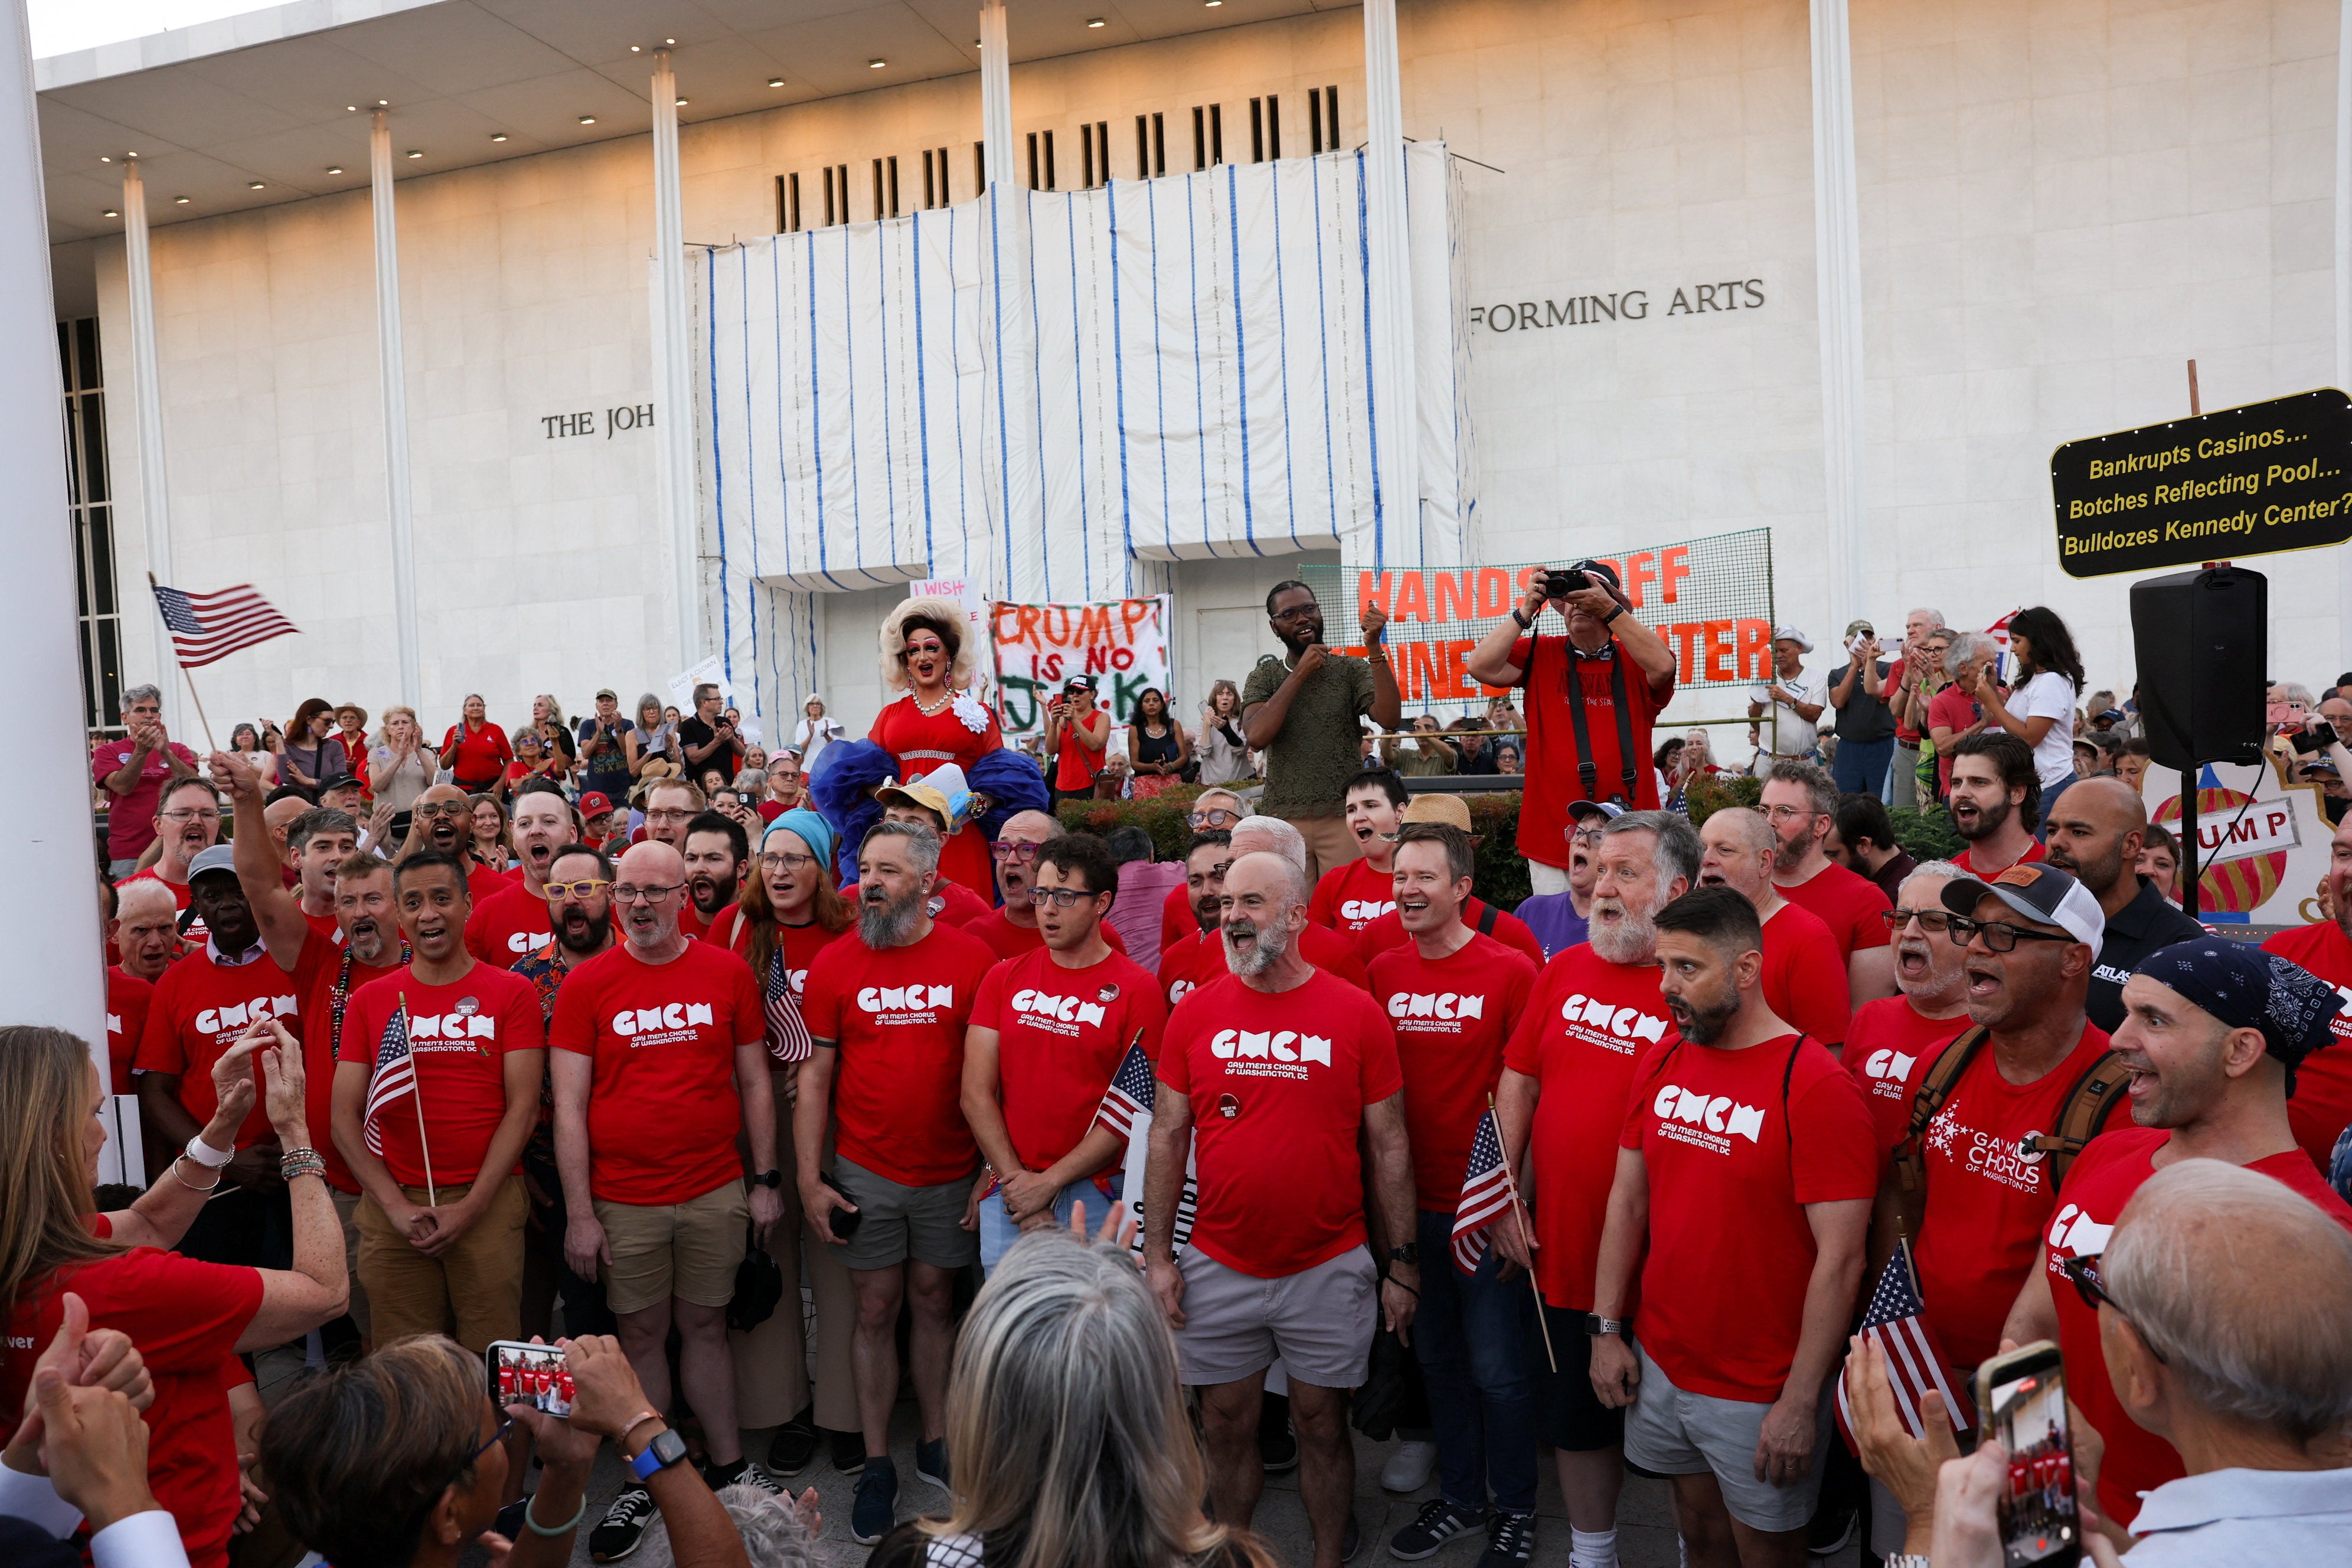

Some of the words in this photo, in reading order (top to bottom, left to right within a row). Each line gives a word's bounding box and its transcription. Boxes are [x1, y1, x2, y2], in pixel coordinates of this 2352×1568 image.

[1667, 278, 1765, 316] ARTS
[541, 411, 594, 440] THE
[606, 403, 654, 440] JOH
[2089, 443, 2190, 479] Bankrupts
[2069, 488, 2148, 519] Botches
[2155, 472, 2259, 505] Reflecting
[2064, 527, 2158, 556] Bulldozes
[2165, 510, 2258, 541] Kennedy
[2264, 492, 2352, 527] Center?
[914, 584, 919, 596] I
[925, 580, 965, 596] WISH
[671, 675, 688, 689] ELECT
[694, 659, 717, 675] CLOWN
[1031, 653, 1064, 681] IS
[1084, 645, 1135, 675] NO
[1056, 1023, 1080, 1031] CHORUS
[1569, 1024, 1585, 1033] GAY
[1609, 1037, 1636, 1048] CHORUS
[1624, 1047, 1635, 1056] DC
[1227, 1061, 1244, 1069] GAY
[1273, 1064, 1308, 1073] CHORUS
[1297, 1072, 1309, 1080] DC
[1876, 1081, 1893, 1090] GAY
[1661, 1122, 1678, 1132] GAY
[1703, 1133, 1731, 1147] CHORUS
[1974, 1132, 2005, 1152] GAY
[1719, 1146, 1730, 1156] DC
[1965, 1163, 1980, 1173] OF
[1968, 1146, 2040, 1184] CHORUS
[2049, 1262, 2059, 1273] OF
